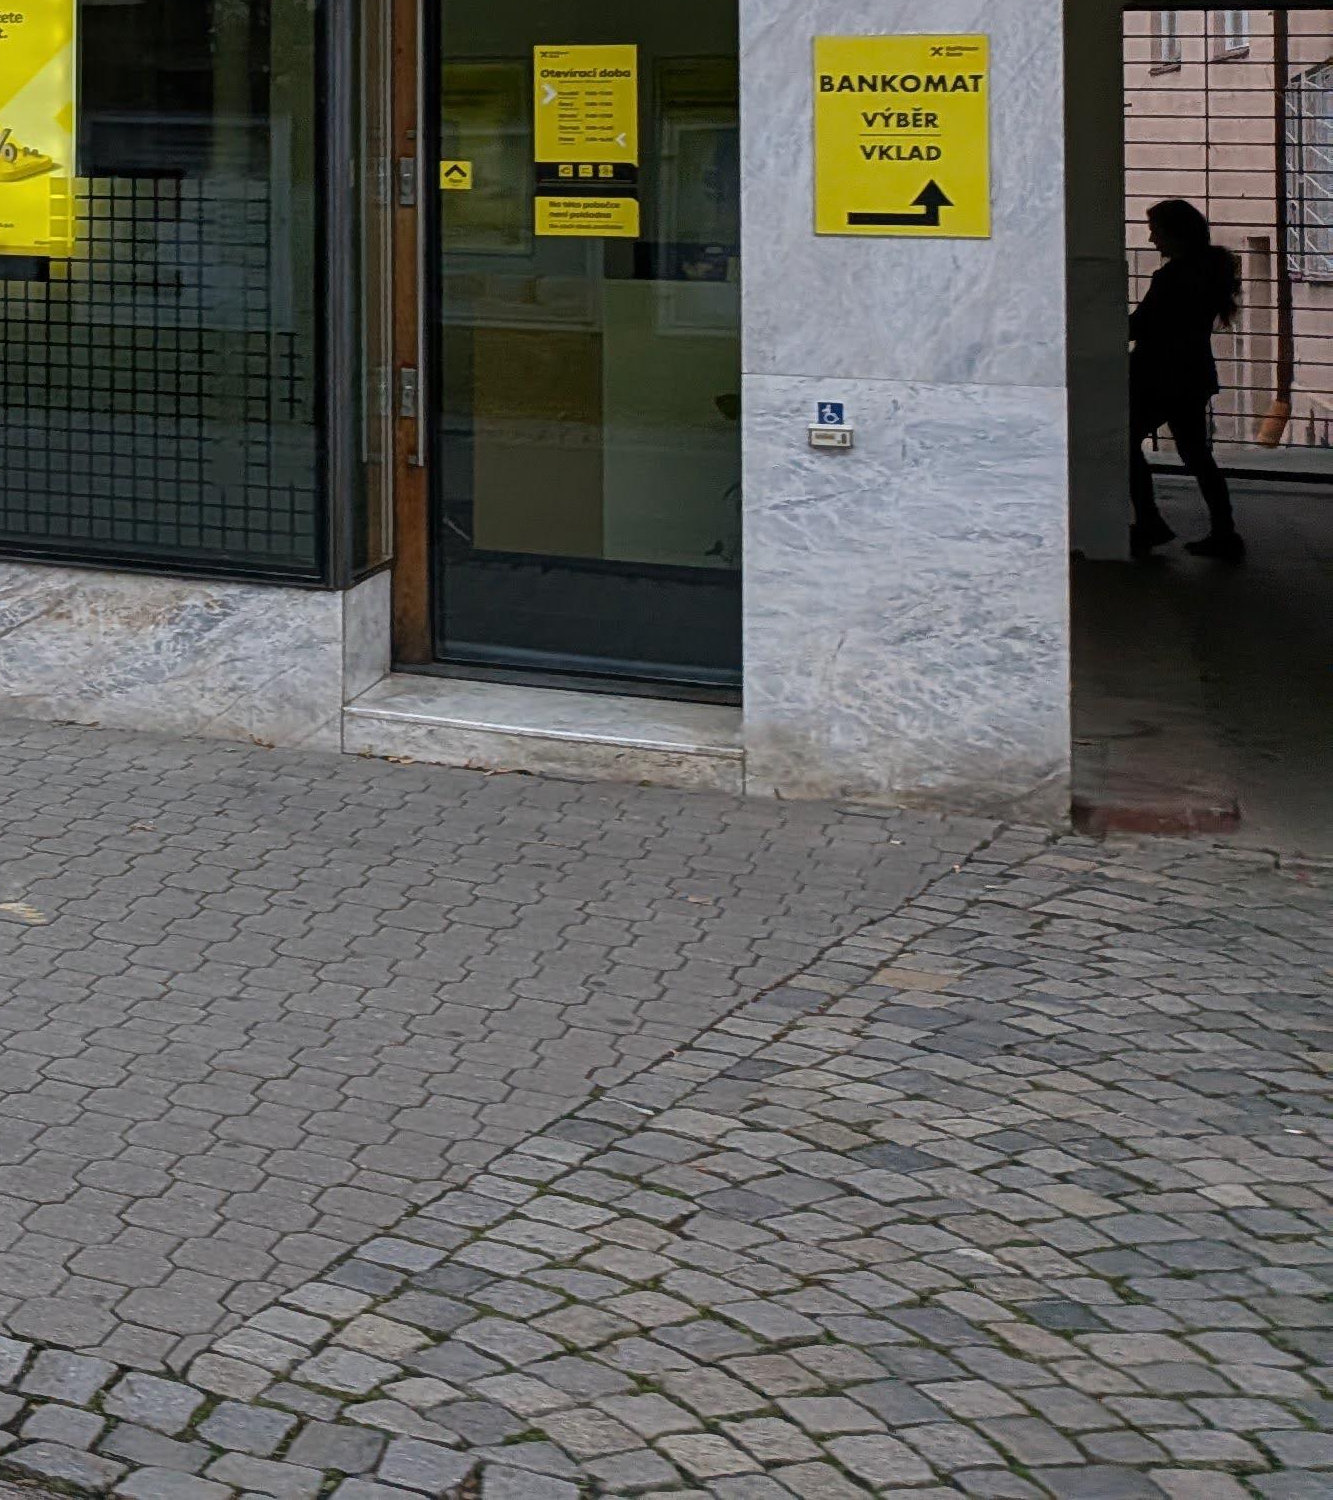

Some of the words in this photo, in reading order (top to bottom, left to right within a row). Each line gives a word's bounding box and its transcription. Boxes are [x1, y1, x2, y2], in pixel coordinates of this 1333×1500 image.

[540, 68, 598, 78] Otevírací
[599, 68, 631, 78] doba
[820, 74, 984, 93] BANKOMAT
[861, 107, 939, 129] VÝBĚR
[860, 145, 942, 161] VKLAD
